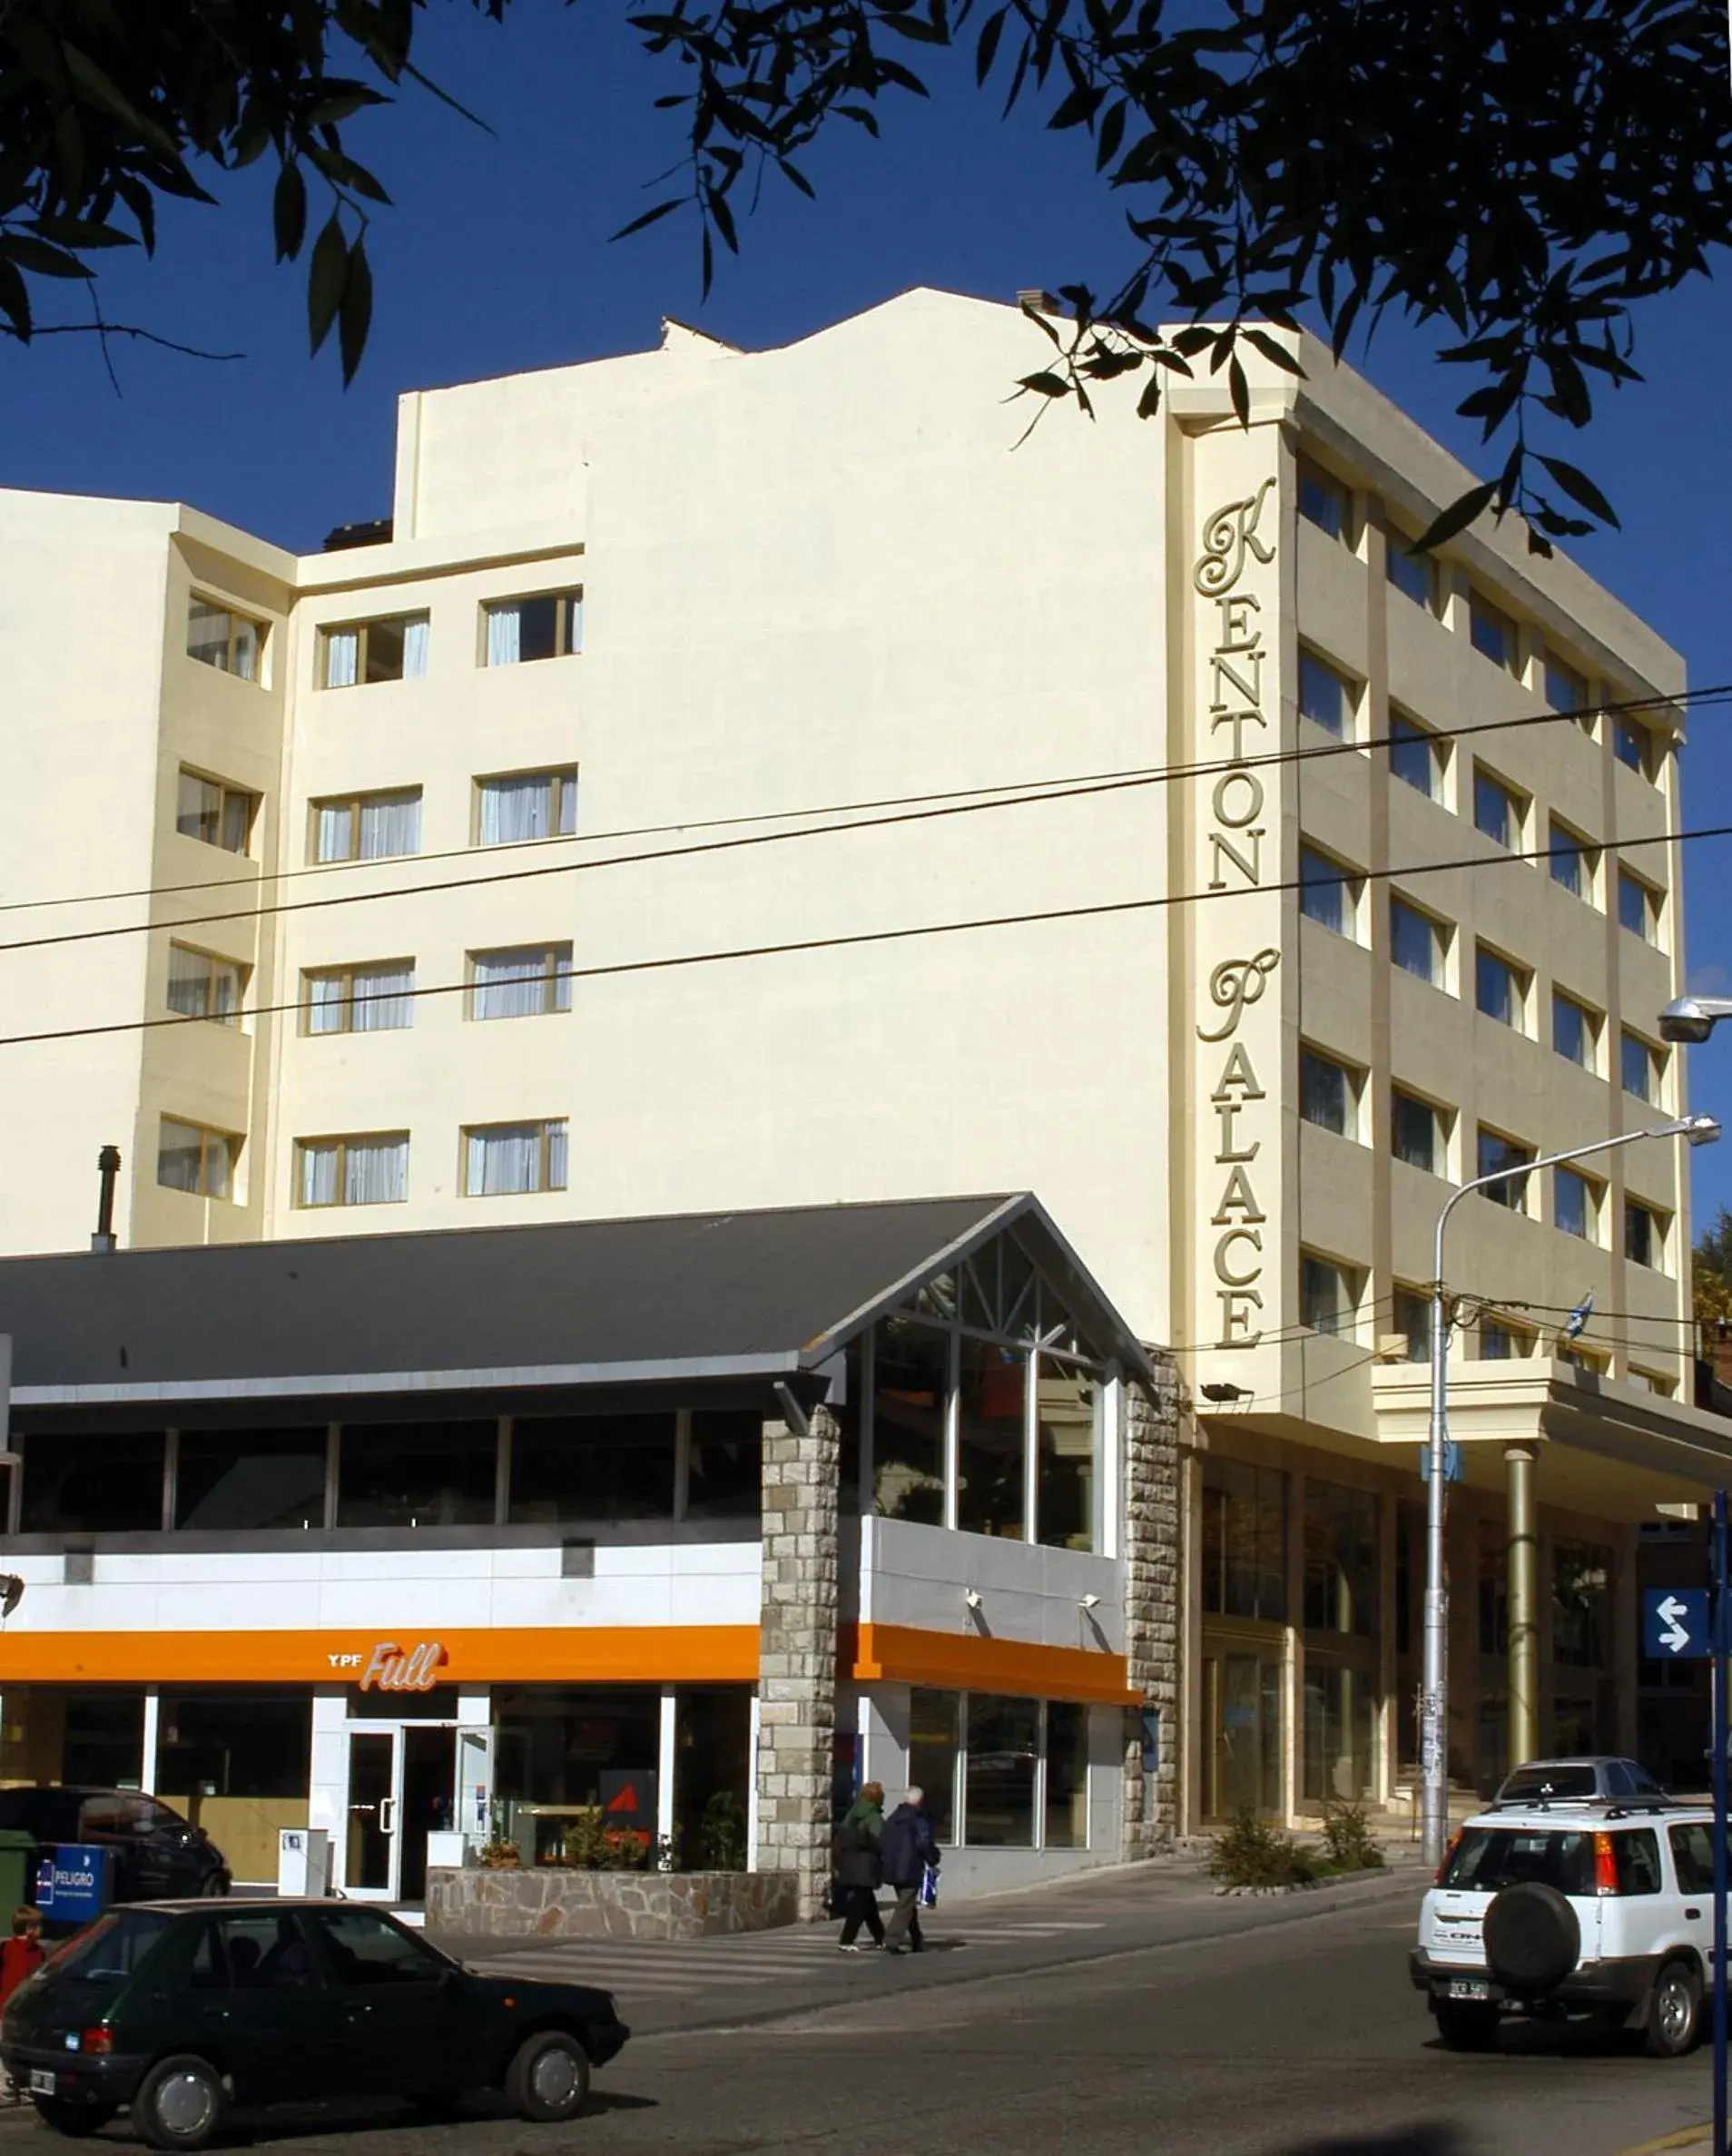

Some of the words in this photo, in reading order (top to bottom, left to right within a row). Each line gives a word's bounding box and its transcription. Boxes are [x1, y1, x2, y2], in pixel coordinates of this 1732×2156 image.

[1193, 476, 1277, 890] KENTON
[1196, 947, 1282, 1350] PALACE
[328, 1654, 362, 1668] YPF
[359, 1641, 441, 1692] Full
[55, 1871, 94, 1886] PELIGRO
